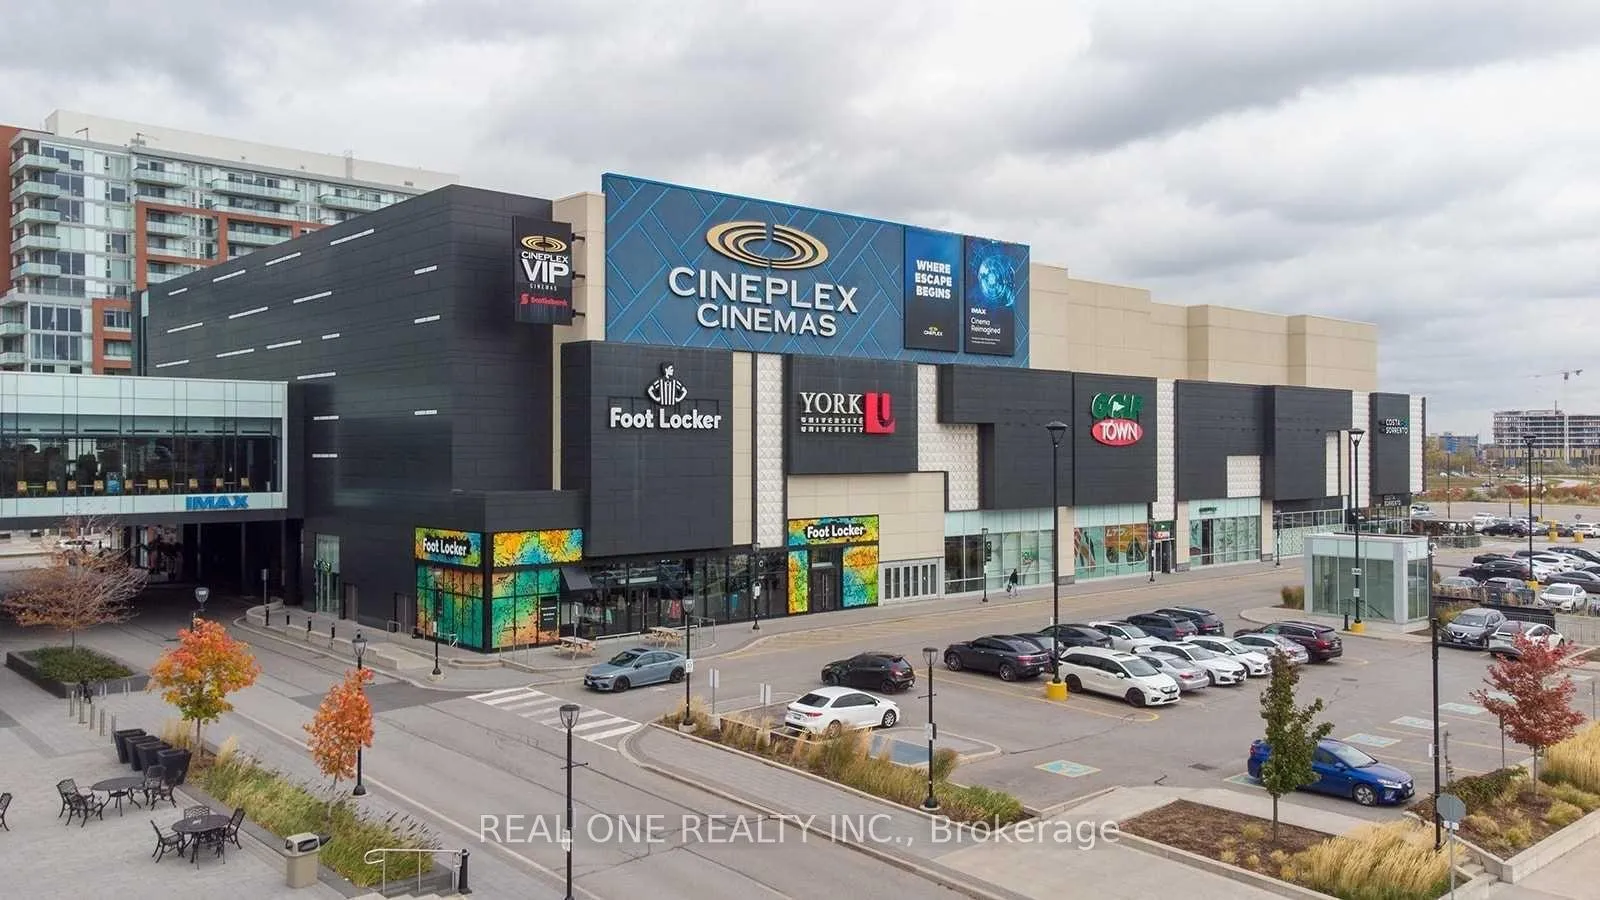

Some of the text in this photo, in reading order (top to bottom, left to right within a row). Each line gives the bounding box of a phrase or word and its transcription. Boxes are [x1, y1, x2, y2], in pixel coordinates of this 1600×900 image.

[521, 251, 568, 263] CINEPLEX
[521, 259, 569, 283] VIP
[916, 260, 951, 274] WHERE
[915, 273, 952, 287] ESCAPE
[668, 267, 858, 313] CINEPLEX
[916, 285, 951, 299] BEGINS
[697, 303, 837, 337] CINEMAS
[971, 317, 991, 325] Cinema
[971, 325, 1001, 336] Reimagined
[800, 392, 864, 414] YORK
[610, 407, 722, 430] Foot Locker
[1101, 422, 1139, 441] TOWN
[185, 495, 249, 511] IMAX
[807, 524, 864, 539] Foot Locker
[422, 538, 467, 557] Foot Locker
